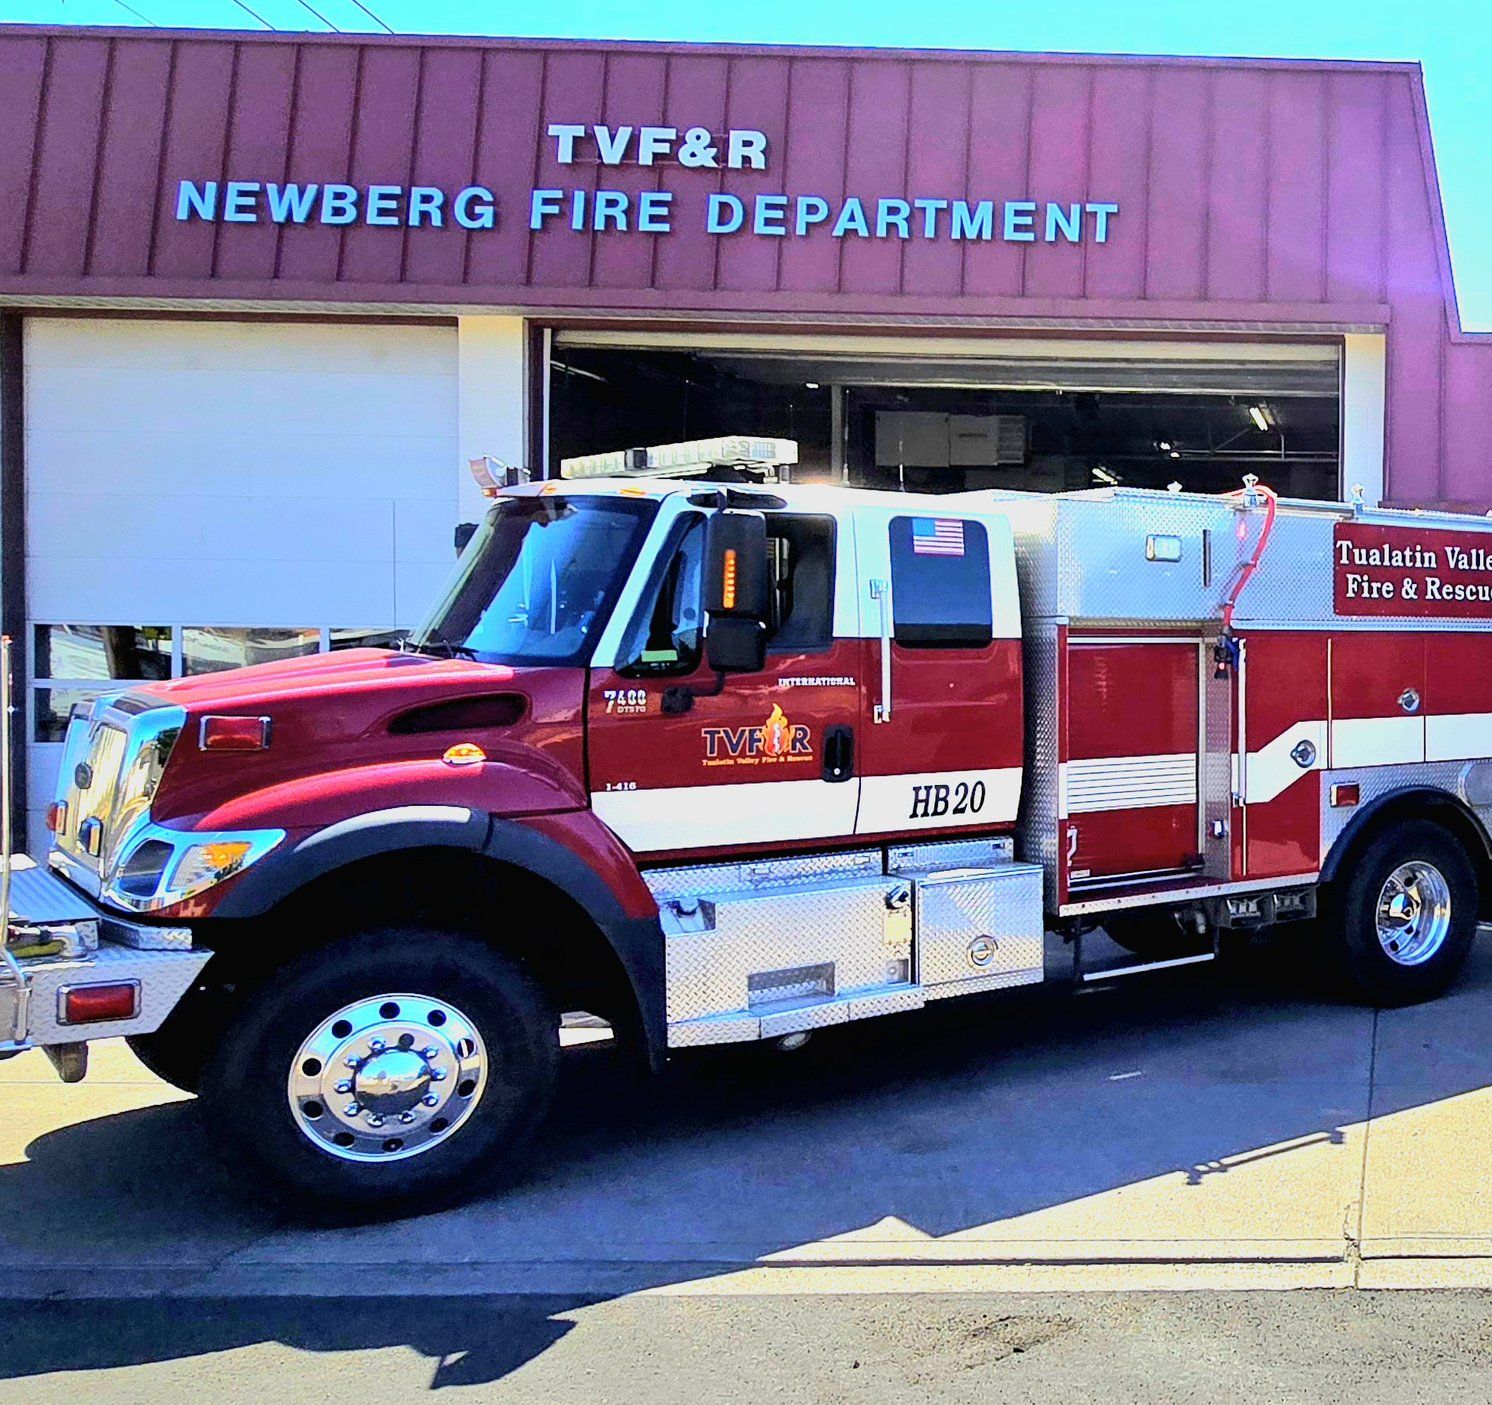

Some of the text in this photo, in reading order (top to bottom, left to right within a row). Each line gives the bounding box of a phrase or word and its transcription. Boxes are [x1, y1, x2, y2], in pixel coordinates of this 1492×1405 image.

[547, 123, 769, 171] TVF&R
[175, 180, 1119, 244] NEWBERG FIRE DEPARTMENT
[1336, 540, 1437, 569] Tualatin
[1345, 573, 1394, 599] Fire
[1401, 577, 1418, 600] &
[778, 677, 855, 686] INTERNATIONAL
